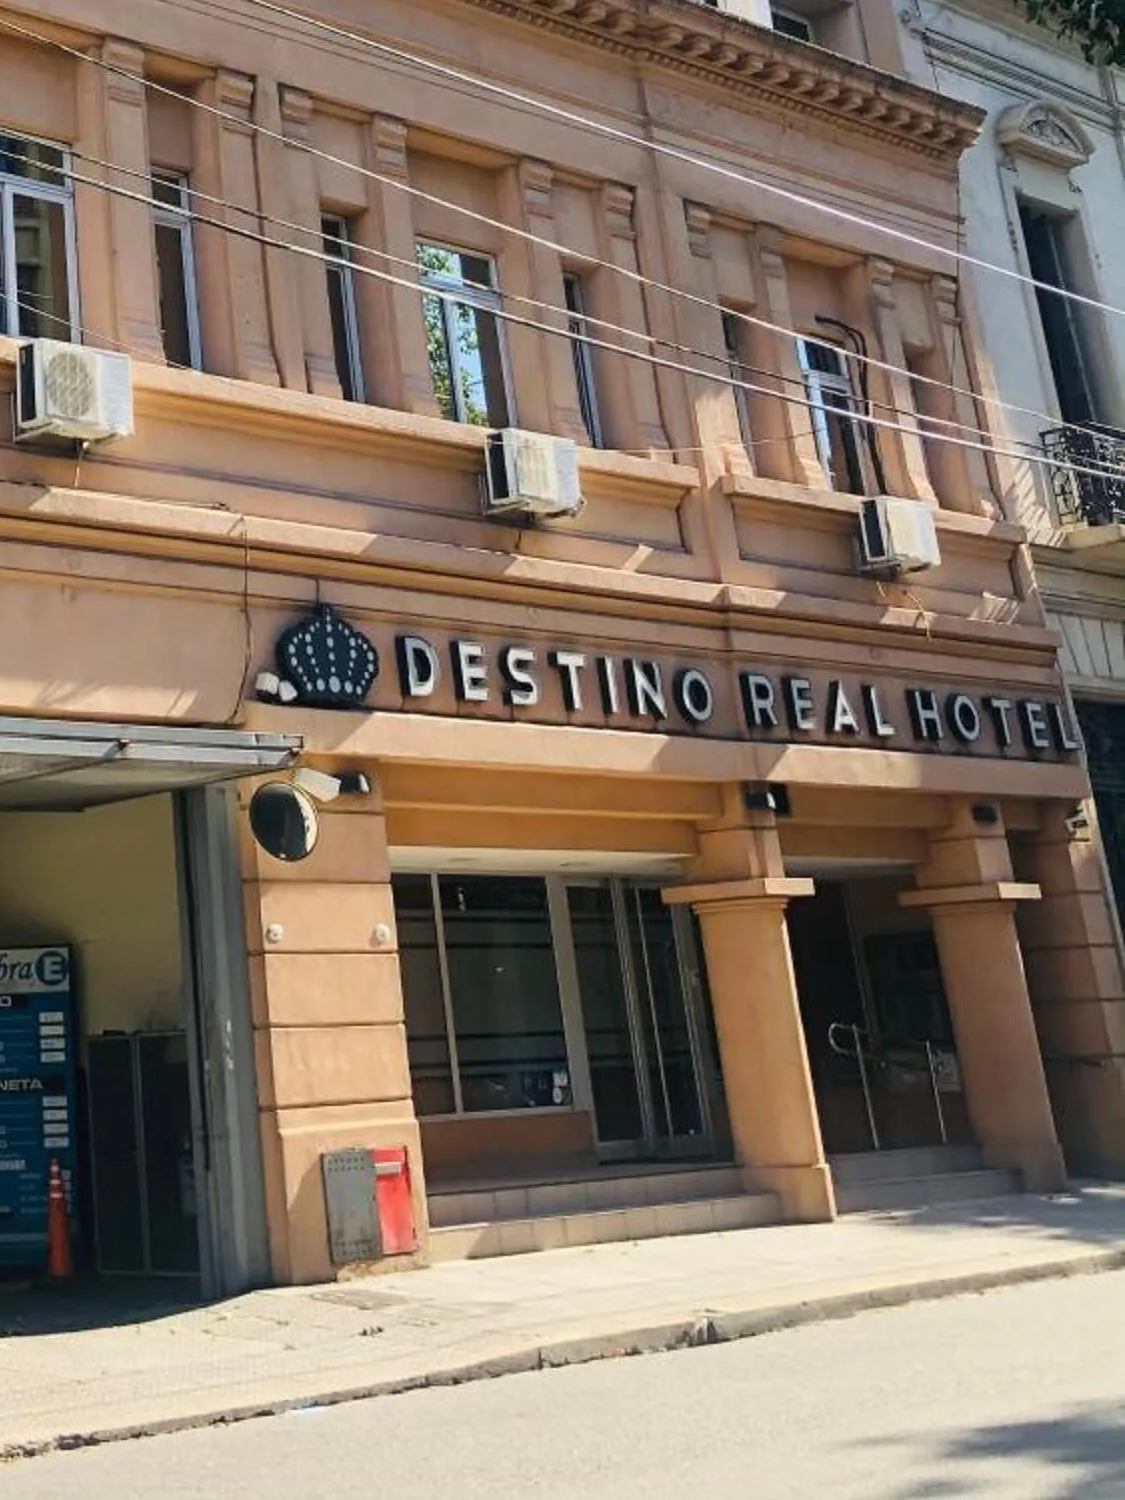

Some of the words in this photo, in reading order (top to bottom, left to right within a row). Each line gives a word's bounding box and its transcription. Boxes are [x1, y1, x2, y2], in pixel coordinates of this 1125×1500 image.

[397, 635, 713, 722] DESTINO
[739, 673, 896, 737] REAL
[906, 687, 1086, 751] HOTEL
[43, 955, 63, 980] E
